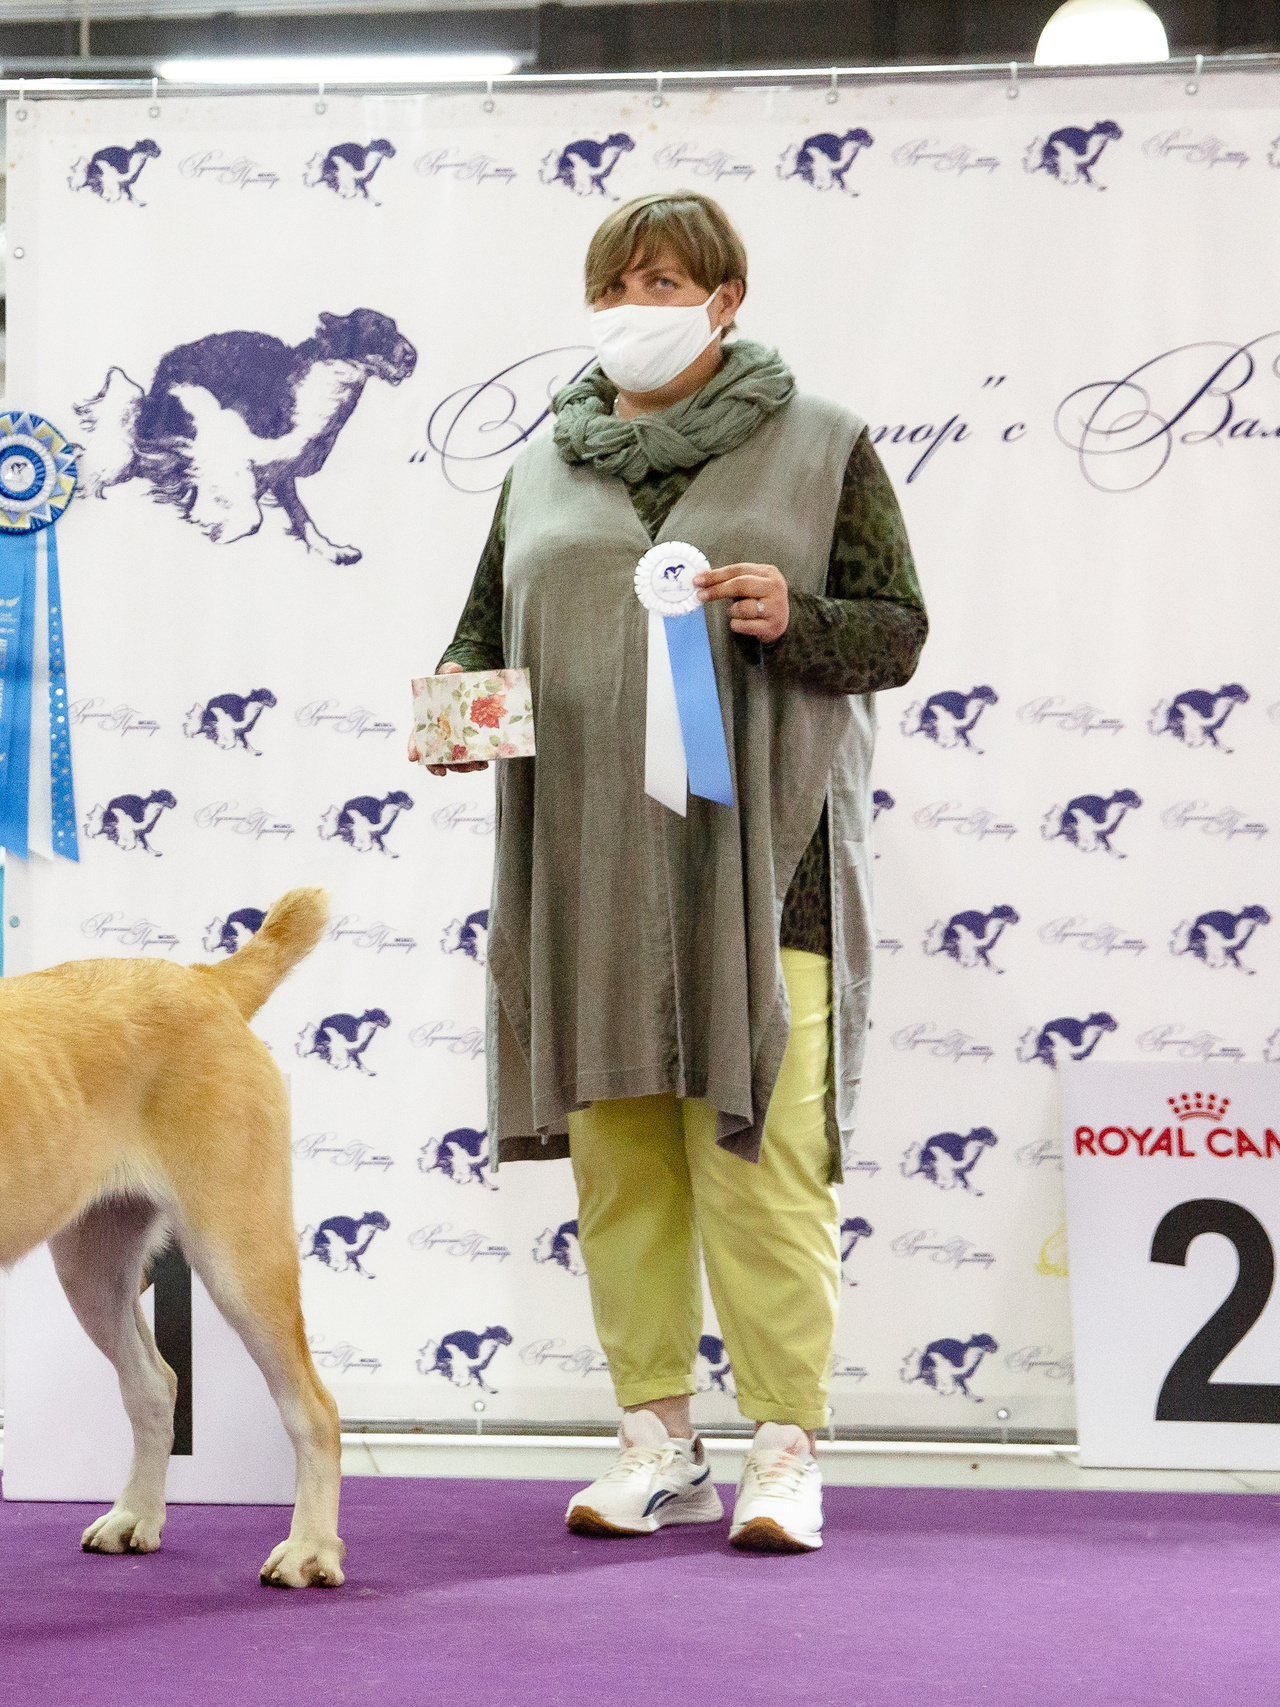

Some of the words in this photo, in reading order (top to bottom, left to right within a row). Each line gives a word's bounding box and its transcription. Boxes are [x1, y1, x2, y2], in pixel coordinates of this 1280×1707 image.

[1074, 1125, 1196, 1158] ROYAL
[1206, 1126, 1280, 1159] CAN
[1149, 1197, 1280, 1425] 2
